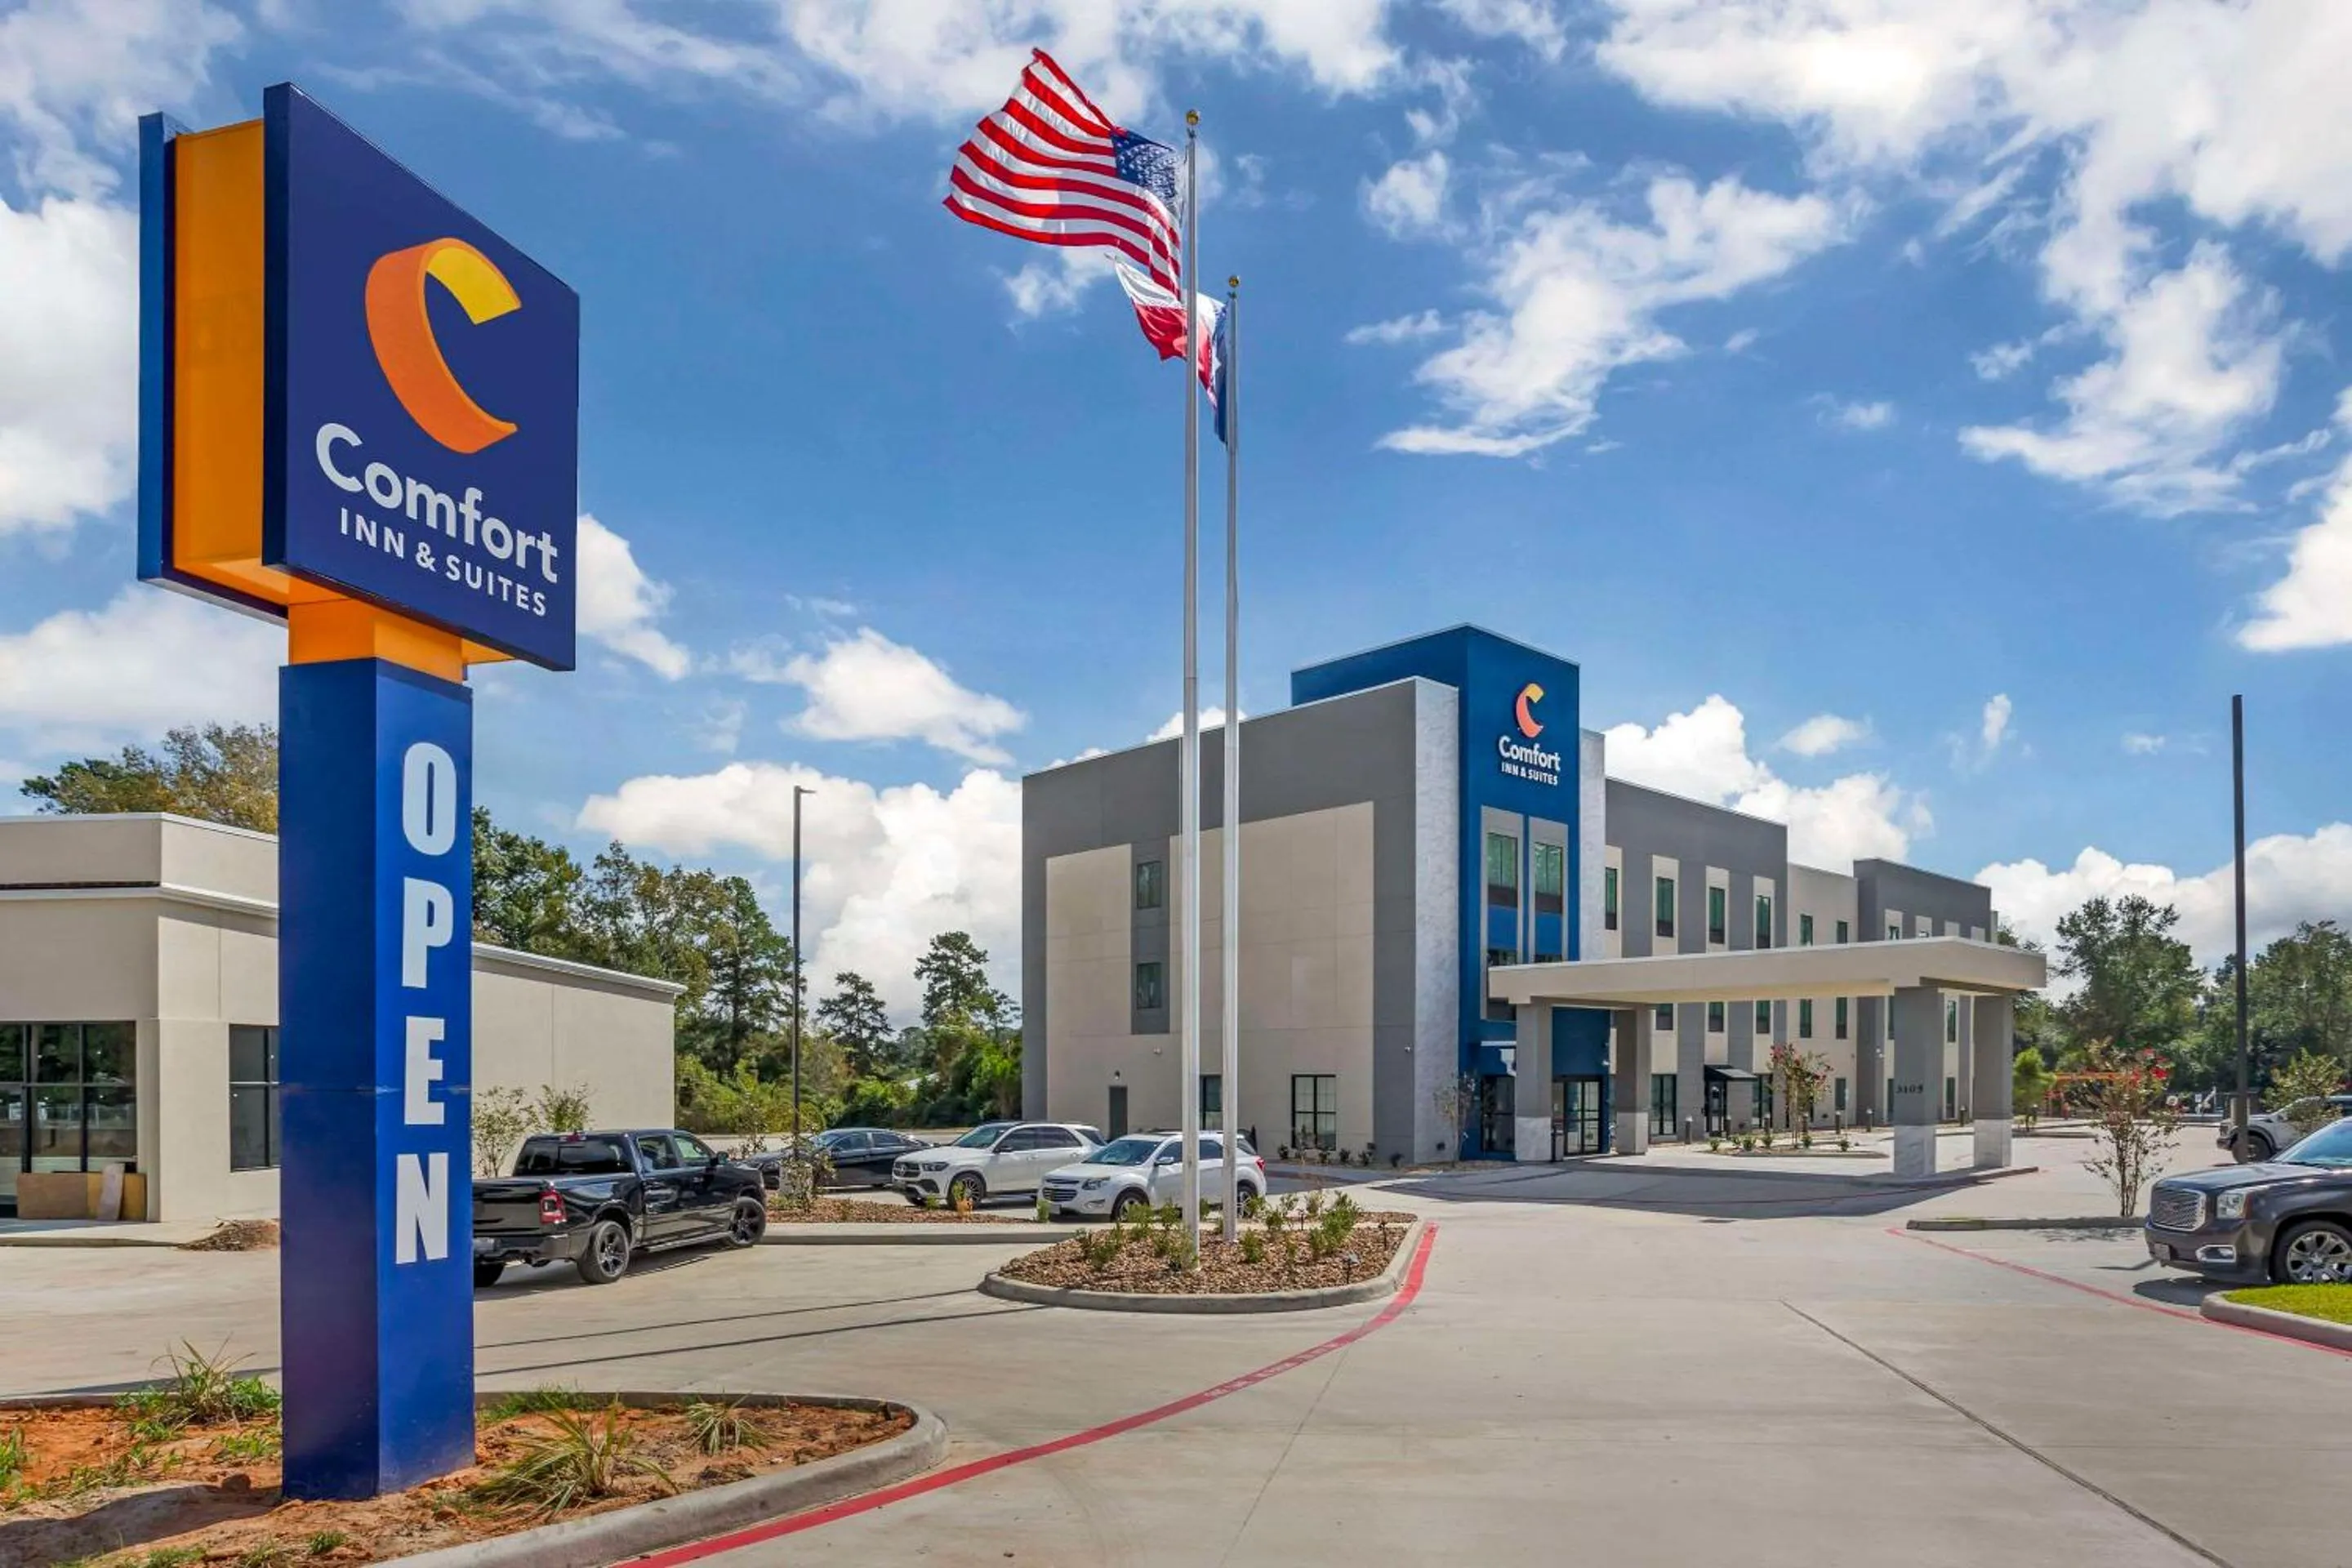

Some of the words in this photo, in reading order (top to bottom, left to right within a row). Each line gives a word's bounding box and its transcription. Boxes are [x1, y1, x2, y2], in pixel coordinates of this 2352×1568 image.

[316, 422, 558, 583] Comfort
[341, 507, 404, 559] INN
[414, 541, 437, 572] &
[445, 555, 546, 617] SUITES
[1499, 735, 1561, 771] Comfort
[1501, 761, 1518, 776] INN
[1528, 769, 1558, 786] SUITES
[395, 742, 457, 1265] OPEN
